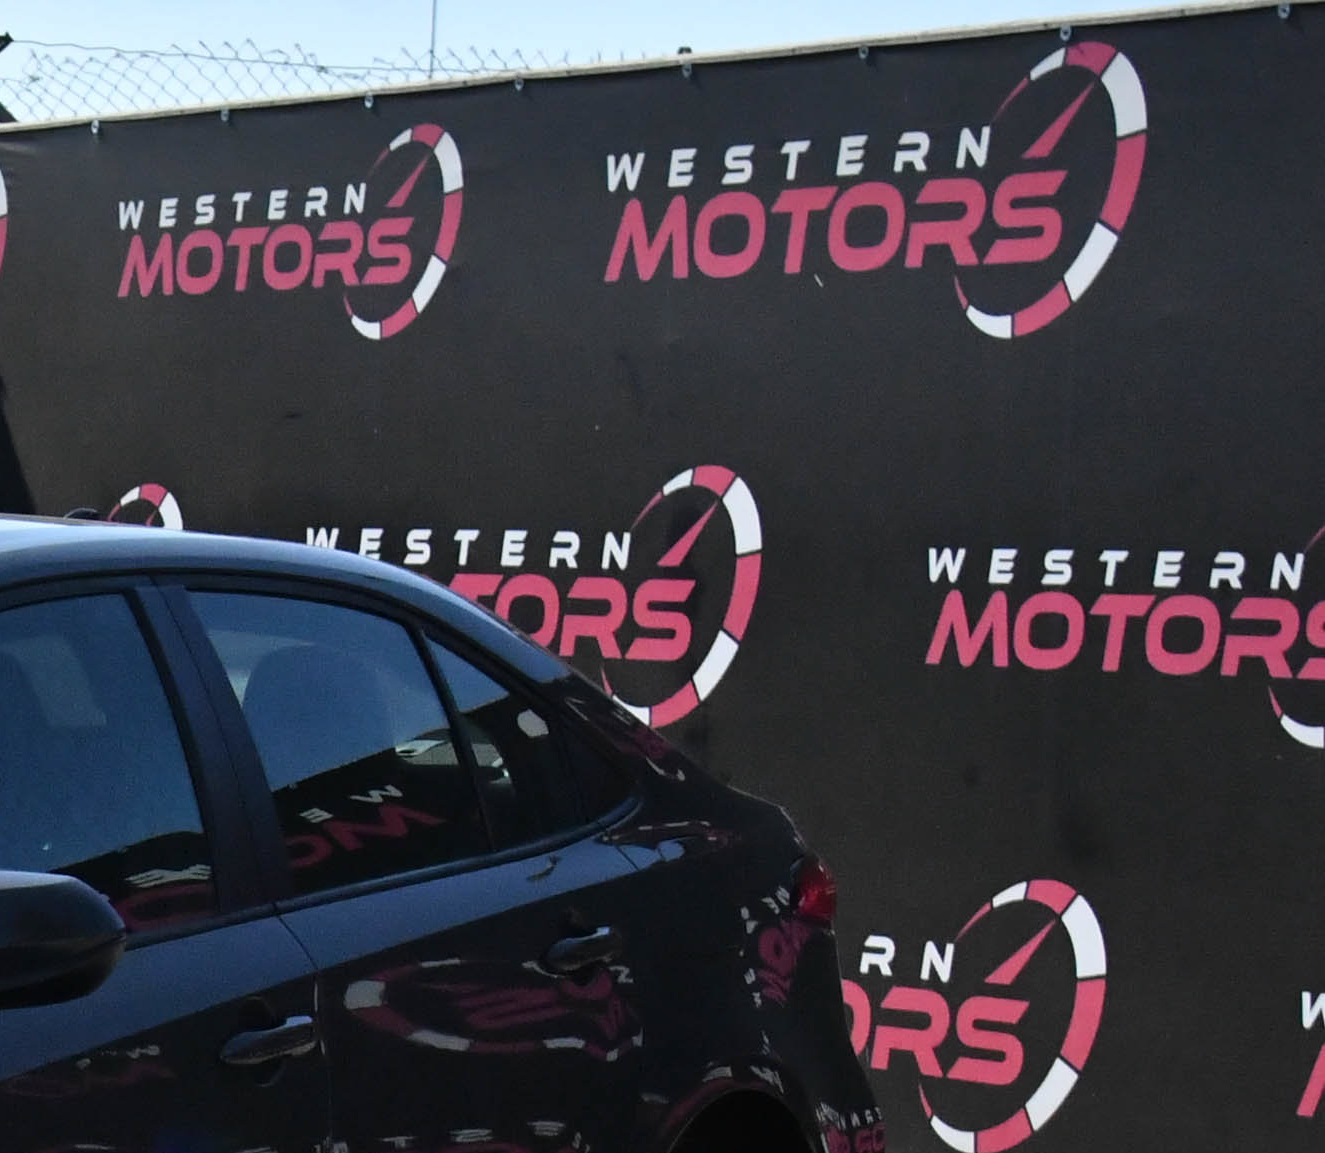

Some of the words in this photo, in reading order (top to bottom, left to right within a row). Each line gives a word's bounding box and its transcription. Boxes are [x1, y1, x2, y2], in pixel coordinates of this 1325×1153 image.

[607, 126, 991, 192] WESTERN
[119, 182, 367, 230] WESTERN
[606, 170, 1068, 281] MOTORS
[118, 215, 416, 297] MOTORS
[928, 547, 1305, 591] WESTERN
